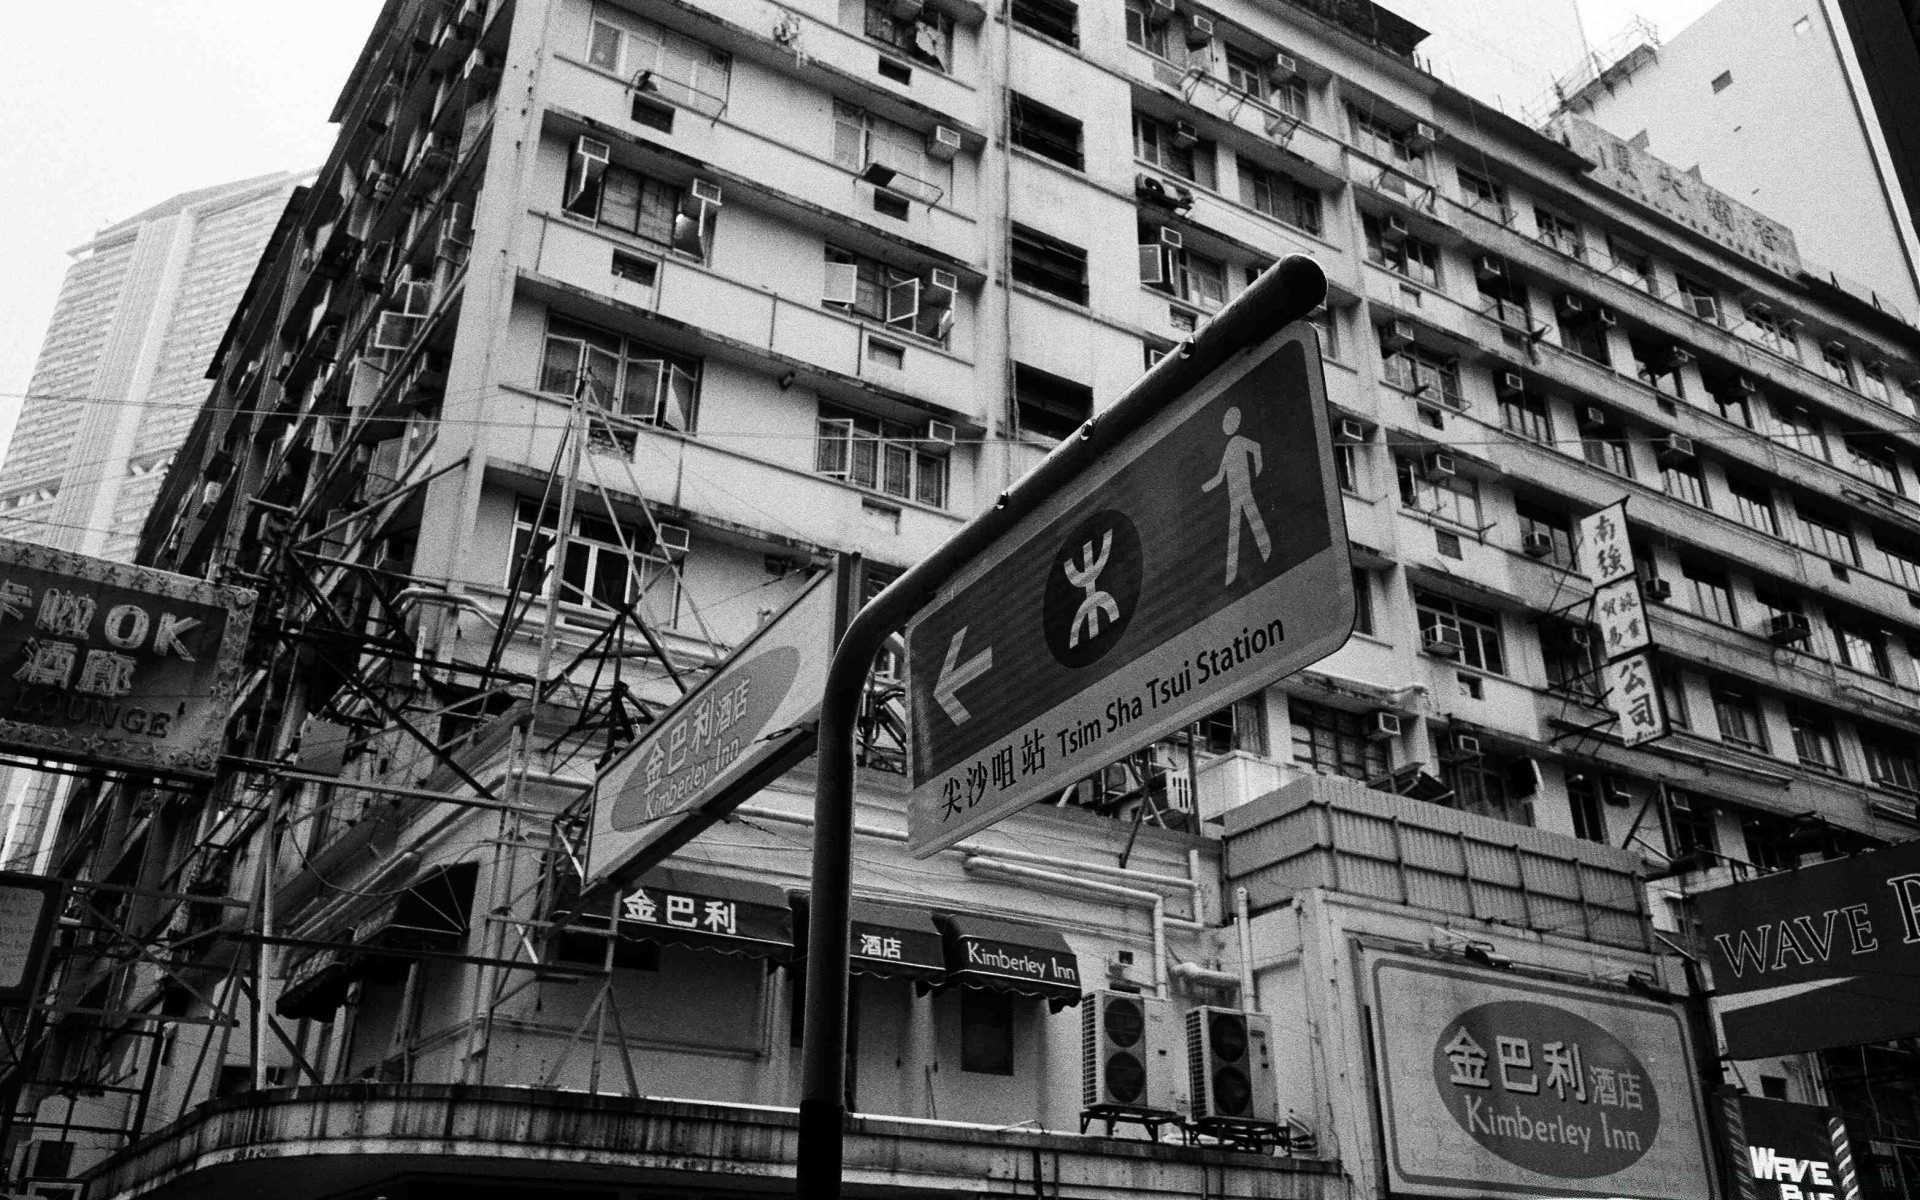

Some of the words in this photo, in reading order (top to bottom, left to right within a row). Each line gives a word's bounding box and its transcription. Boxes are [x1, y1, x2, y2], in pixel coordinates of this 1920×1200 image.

[13, 685, 173, 739] LOUNGE
[1057, 716, 1101, 759] Tsim
[1106, 694, 1143, 734] Sha
[1146, 660, 1192, 708] Tsui
[1196, 617, 1286, 685] Station
[1619, 659, 1656, 727] 公司
[644, 758, 711, 821] Kimberley
[715, 735, 740, 773] Inn
[942, 728, 1047, 822] 尖沙咀站
[622, 887, 738, 935] 金巴利
[1714, 902, 1879, 978] WAVE
[860, 933, 903, 960] 酒店
[967, 940, 1046, 979] Kimberley
[1051, 956, 1077, 981] Inn
[1464, 1094, 1592, 1154] Kimberley
[1600, 1111, 1642, 1152] Inn
[1749, 1145, 1834, 1187] WAVE
